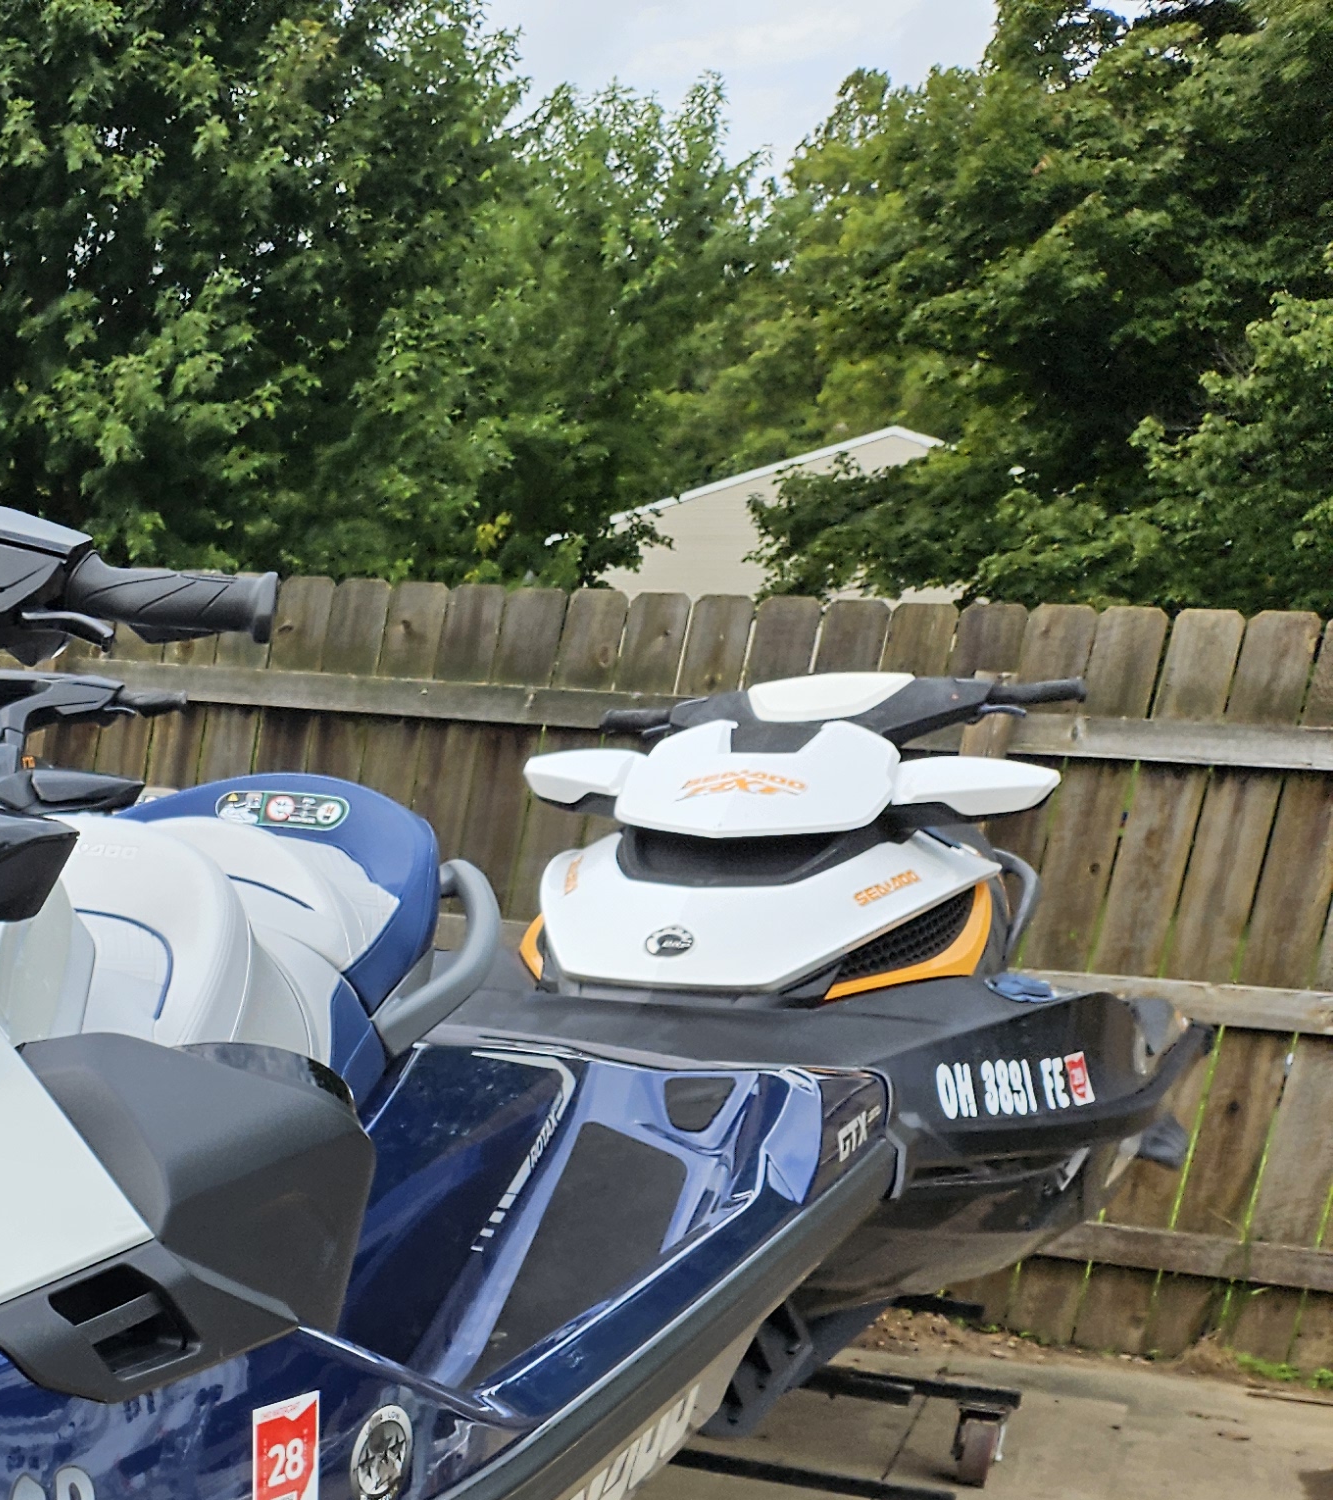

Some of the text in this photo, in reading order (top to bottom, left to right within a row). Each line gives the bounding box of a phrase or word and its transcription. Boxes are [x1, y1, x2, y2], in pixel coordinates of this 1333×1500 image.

[936, 1062, 978, 1120] OH
[980, 1058, 1038, 1116] 3891
[529, 1110, 558, 1169] ROTAX
[837, 1110, 868, 1163] GTX
[267, 1437, 305, 1488] 28
